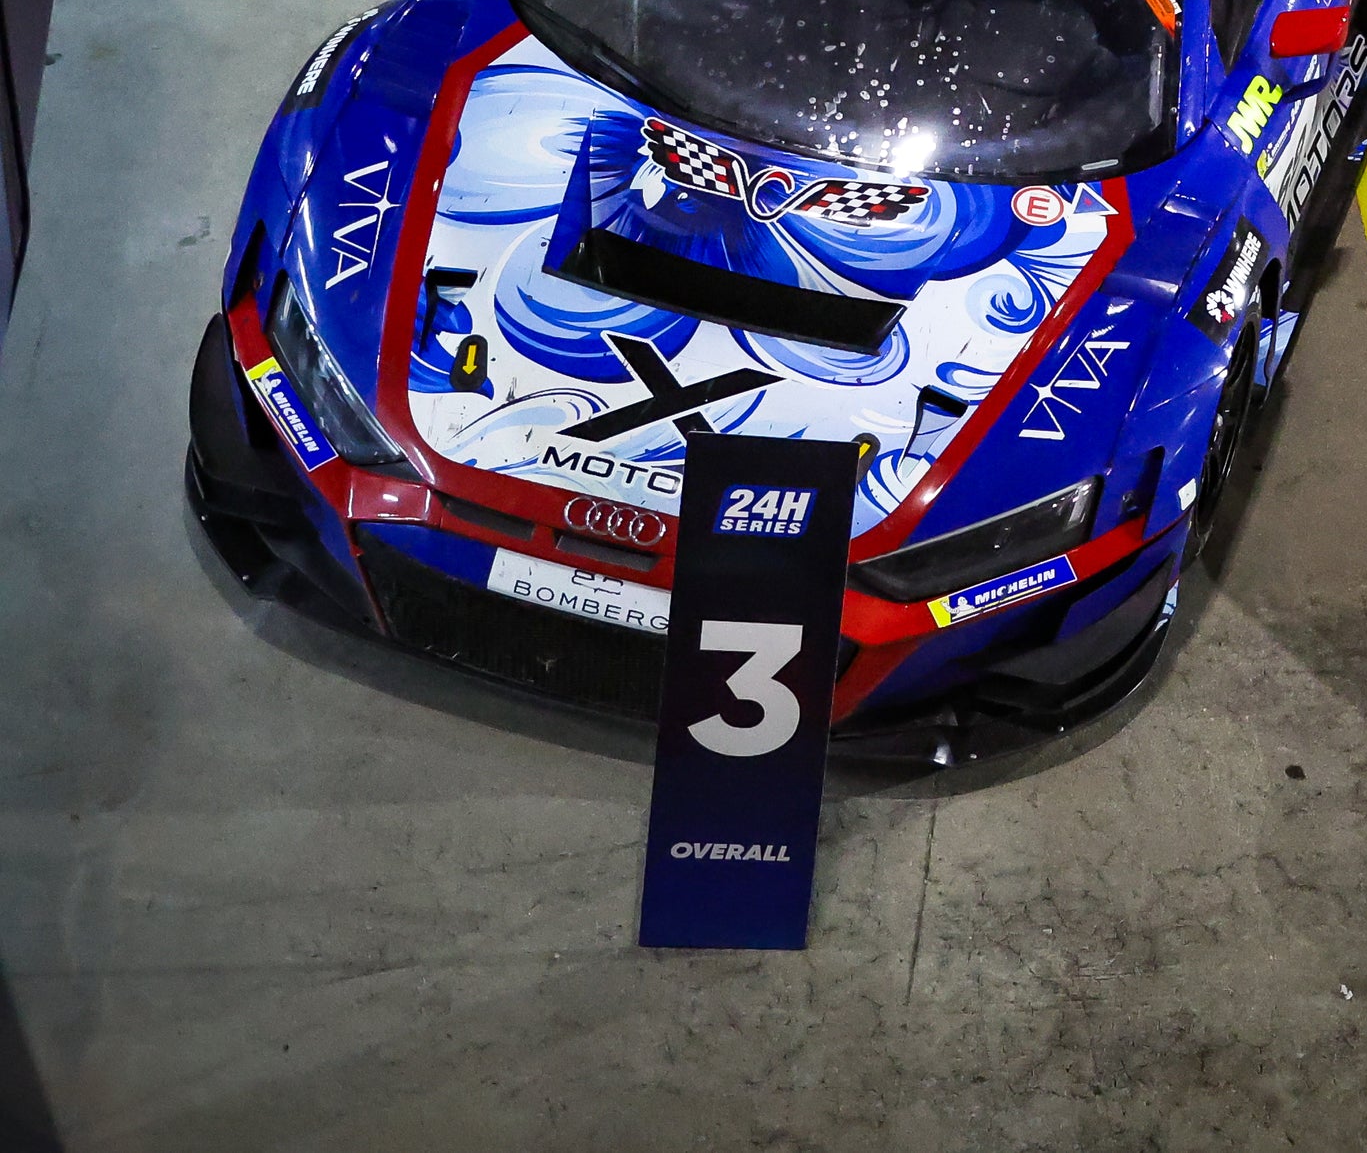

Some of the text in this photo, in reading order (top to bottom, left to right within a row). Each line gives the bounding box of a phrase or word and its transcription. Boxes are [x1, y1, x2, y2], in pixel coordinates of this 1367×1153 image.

[1226, 74, 1284, 156] JWR
[1027, 196, 1051, 219] E
[1221, 231, 1262, 296] WINHERE
[272, 390, 320, 454] MICHELIN
[719, 518, 803, 535] SERIES
[727, 488, 813, 521] 24H
[512, 579, 672, 631] BOMBERG
[974, 568, 1055, 606] MICHELIN
[686, 619, 805, 758] 3
[669, 841, 791, 863] OVERALL
